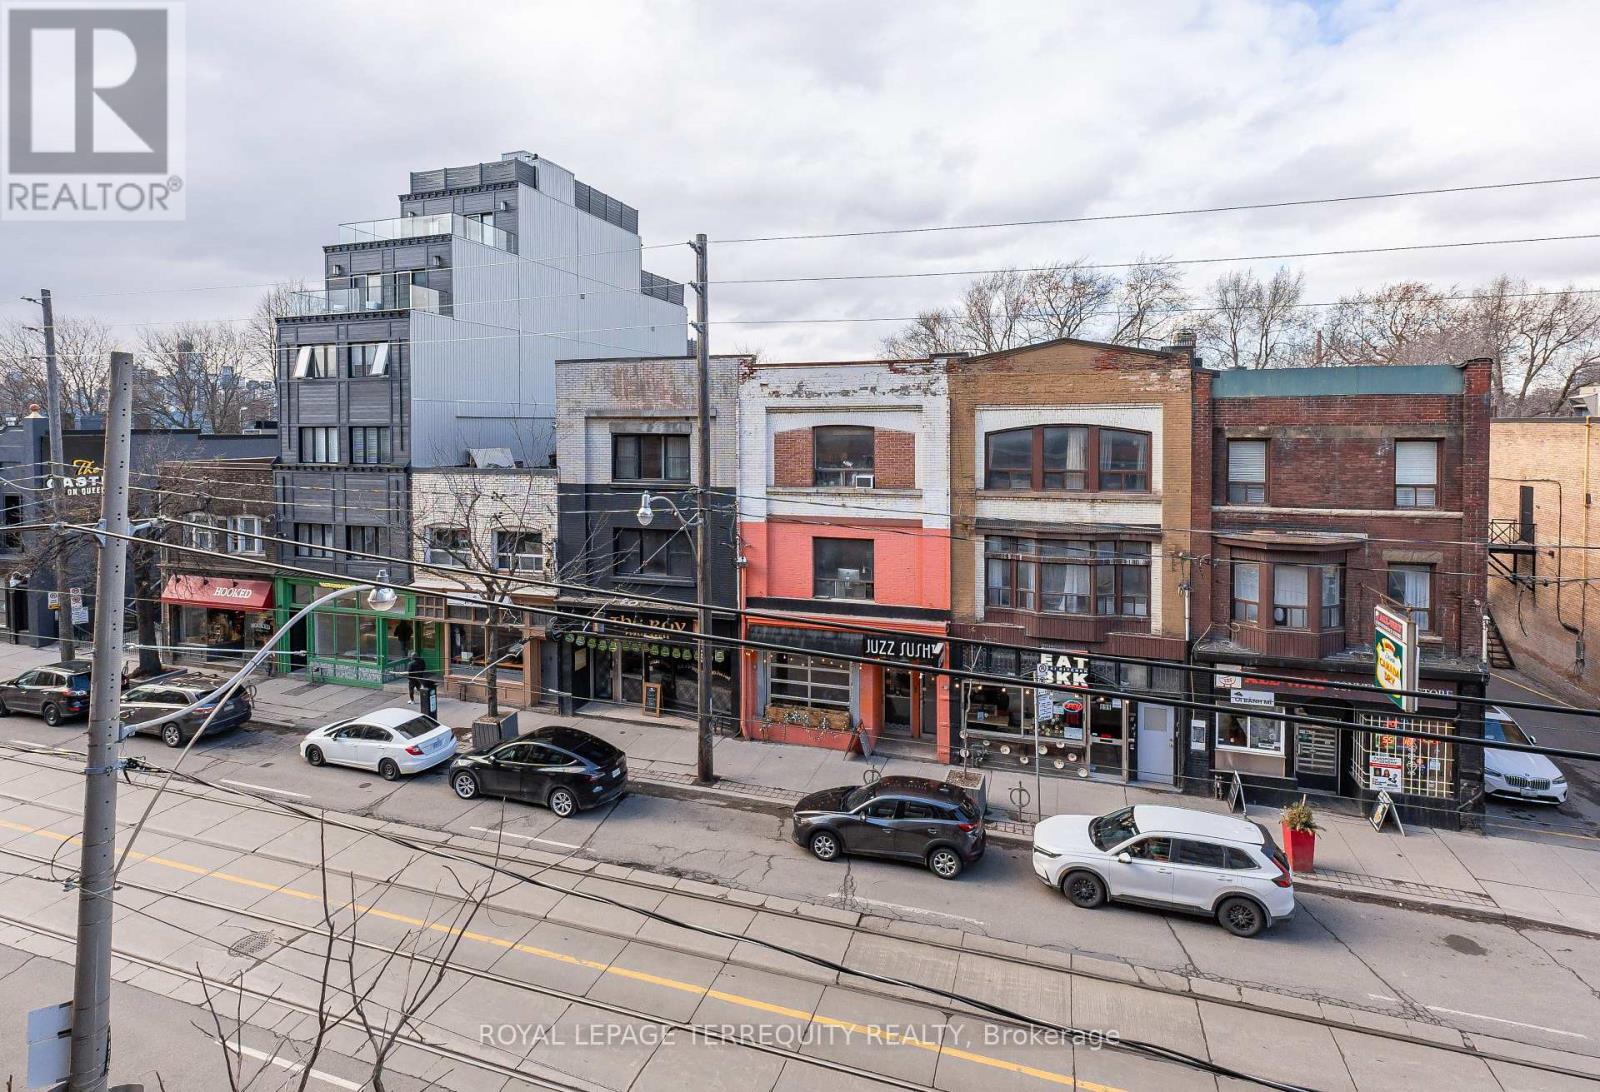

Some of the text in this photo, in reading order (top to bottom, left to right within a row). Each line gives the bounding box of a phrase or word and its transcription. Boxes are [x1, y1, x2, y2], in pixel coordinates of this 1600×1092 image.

[73, 459, 100, 476] The
[67, 488, 78, 496] ON
[214, 586, 252, 599] HOOKED
[866, 639, 896, 656] JUZZ
[1040, 653, 1089, 669] EAT
[1379, 657, 1400, 678] CANADA
